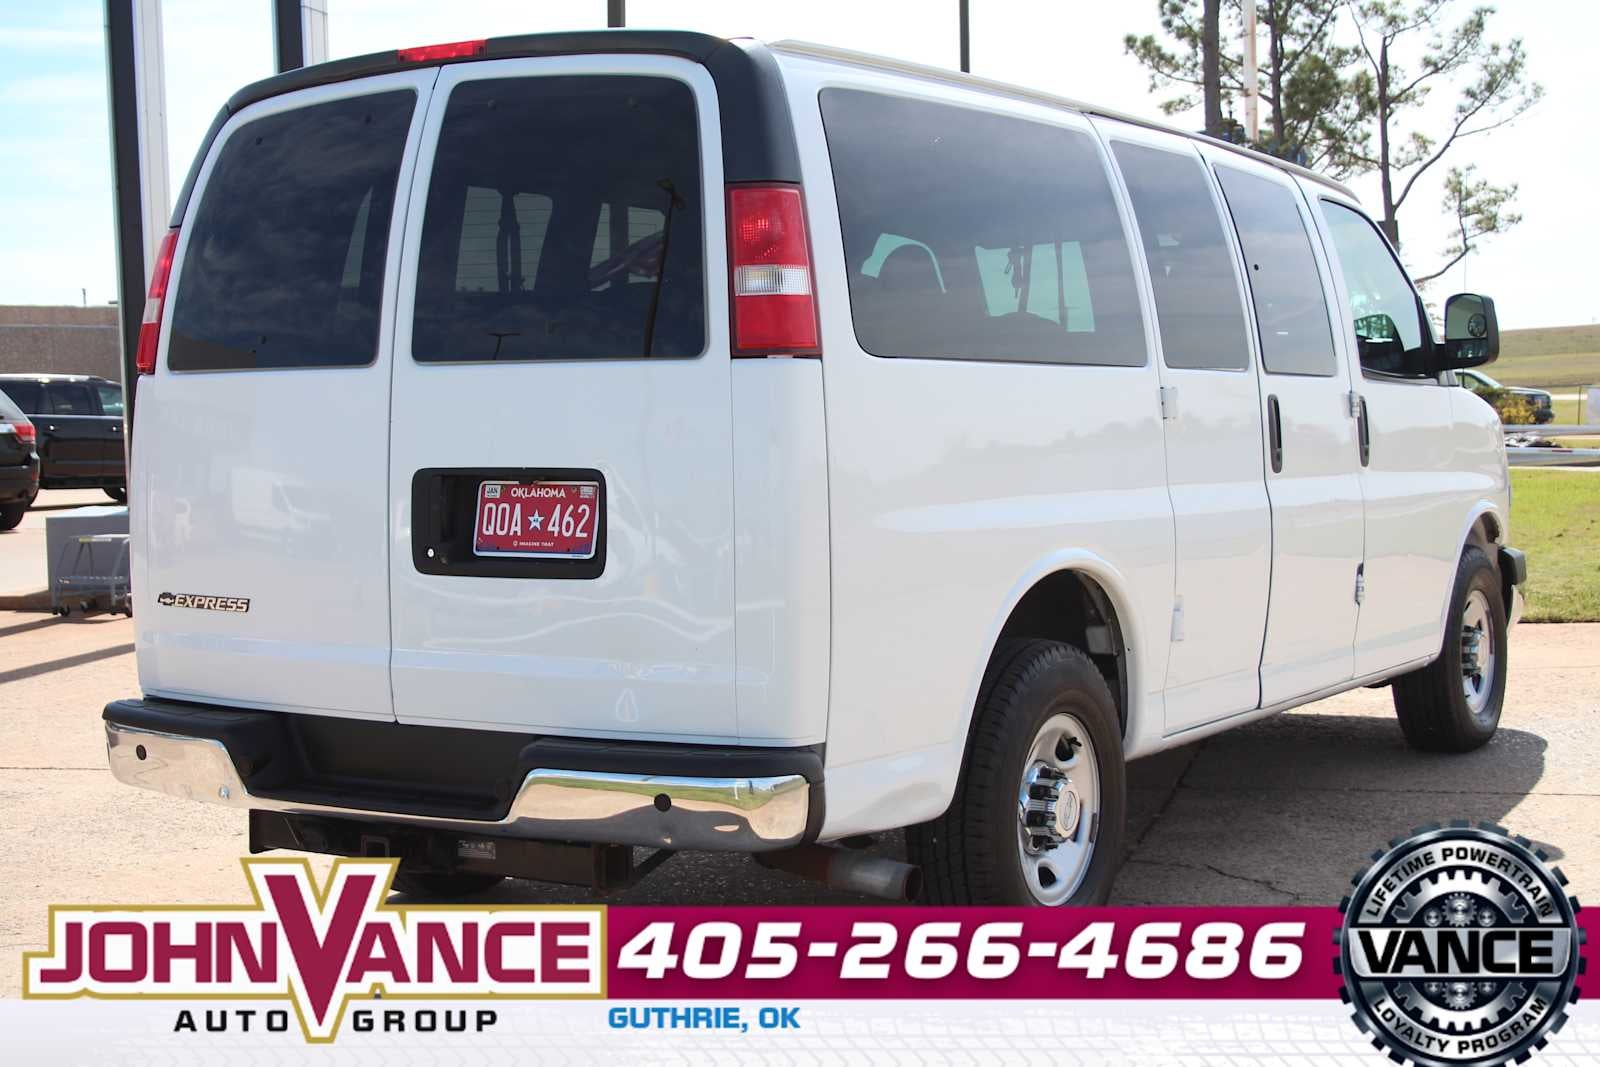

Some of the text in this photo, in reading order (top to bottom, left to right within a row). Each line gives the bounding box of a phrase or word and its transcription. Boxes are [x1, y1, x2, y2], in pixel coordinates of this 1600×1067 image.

[510, 487, 566, 498] OKLAHOMA
[482, 503, 590, 538] QOA 462
[174, 594, 250, 612] EXPRESS
